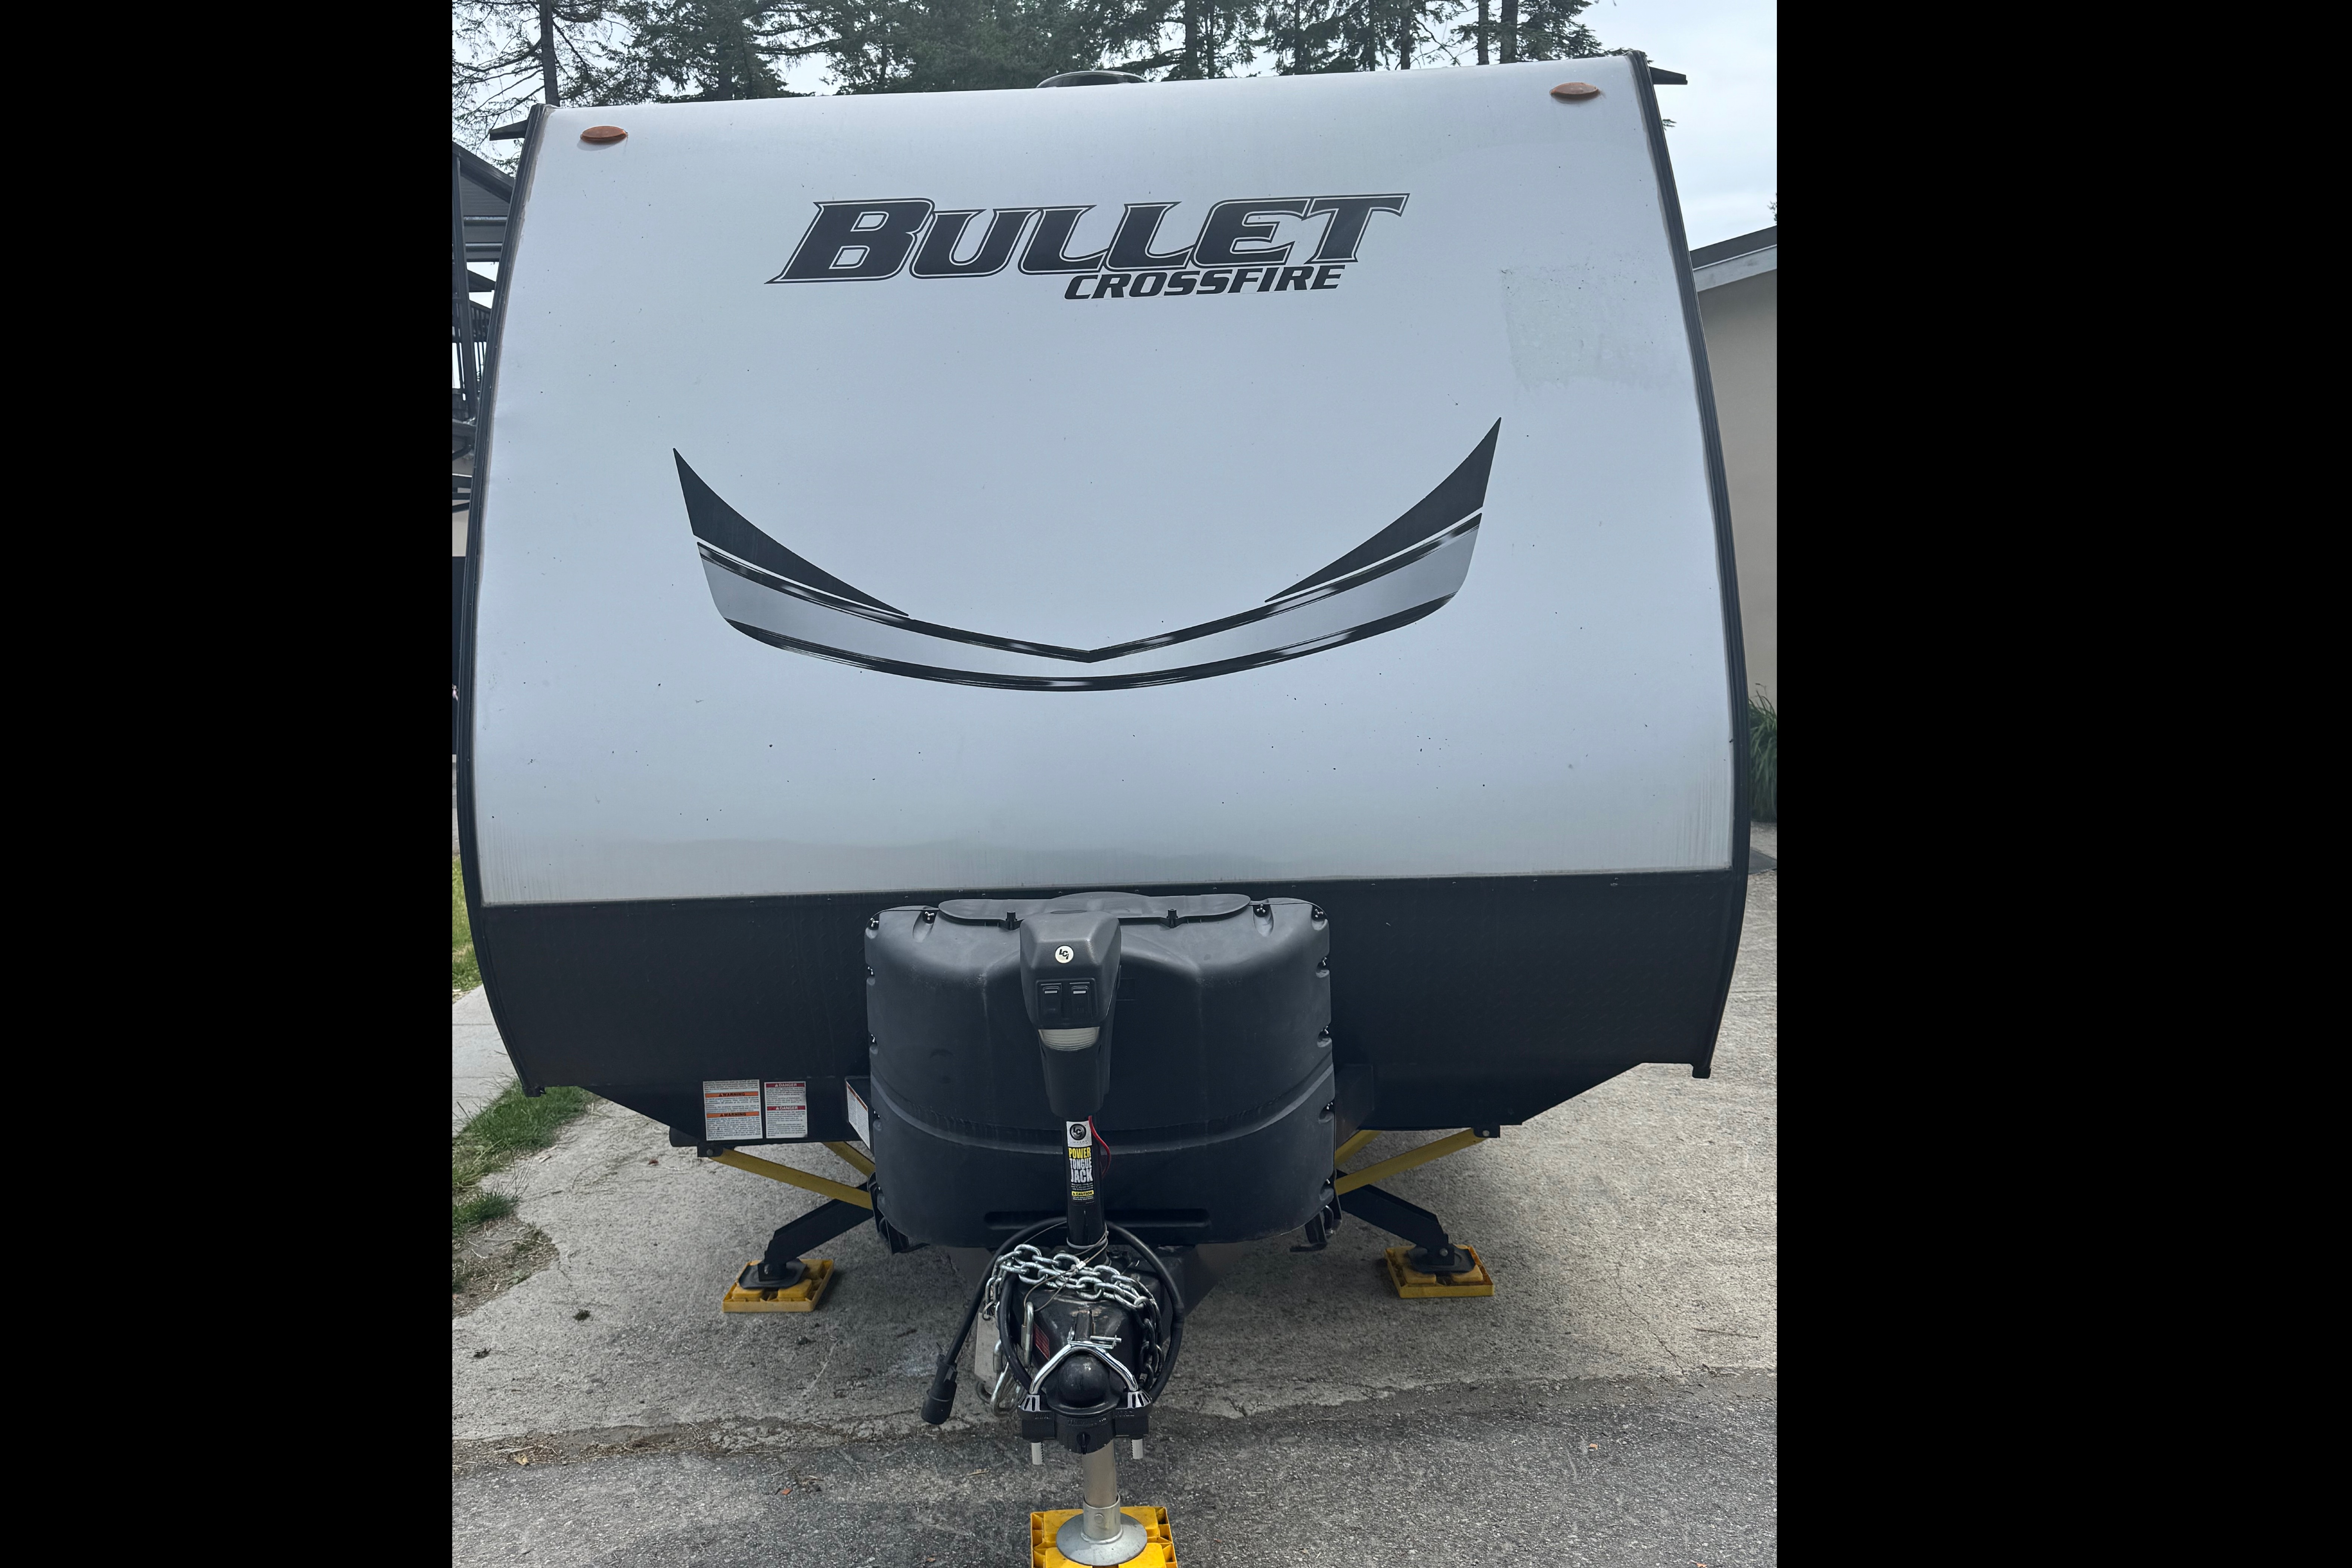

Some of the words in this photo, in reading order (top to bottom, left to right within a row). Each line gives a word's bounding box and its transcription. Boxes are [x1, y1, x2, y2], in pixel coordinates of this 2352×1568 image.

[764, 193, 1410, 285] BULLET
[1065, 264, 1346, 300] CROSSFIRE
[1068, 1147, 1091, 1159] POWER
[1070, 1157, 1092, 1170] TONGUE
[1071, 1168, 1093, 1183] JACK
